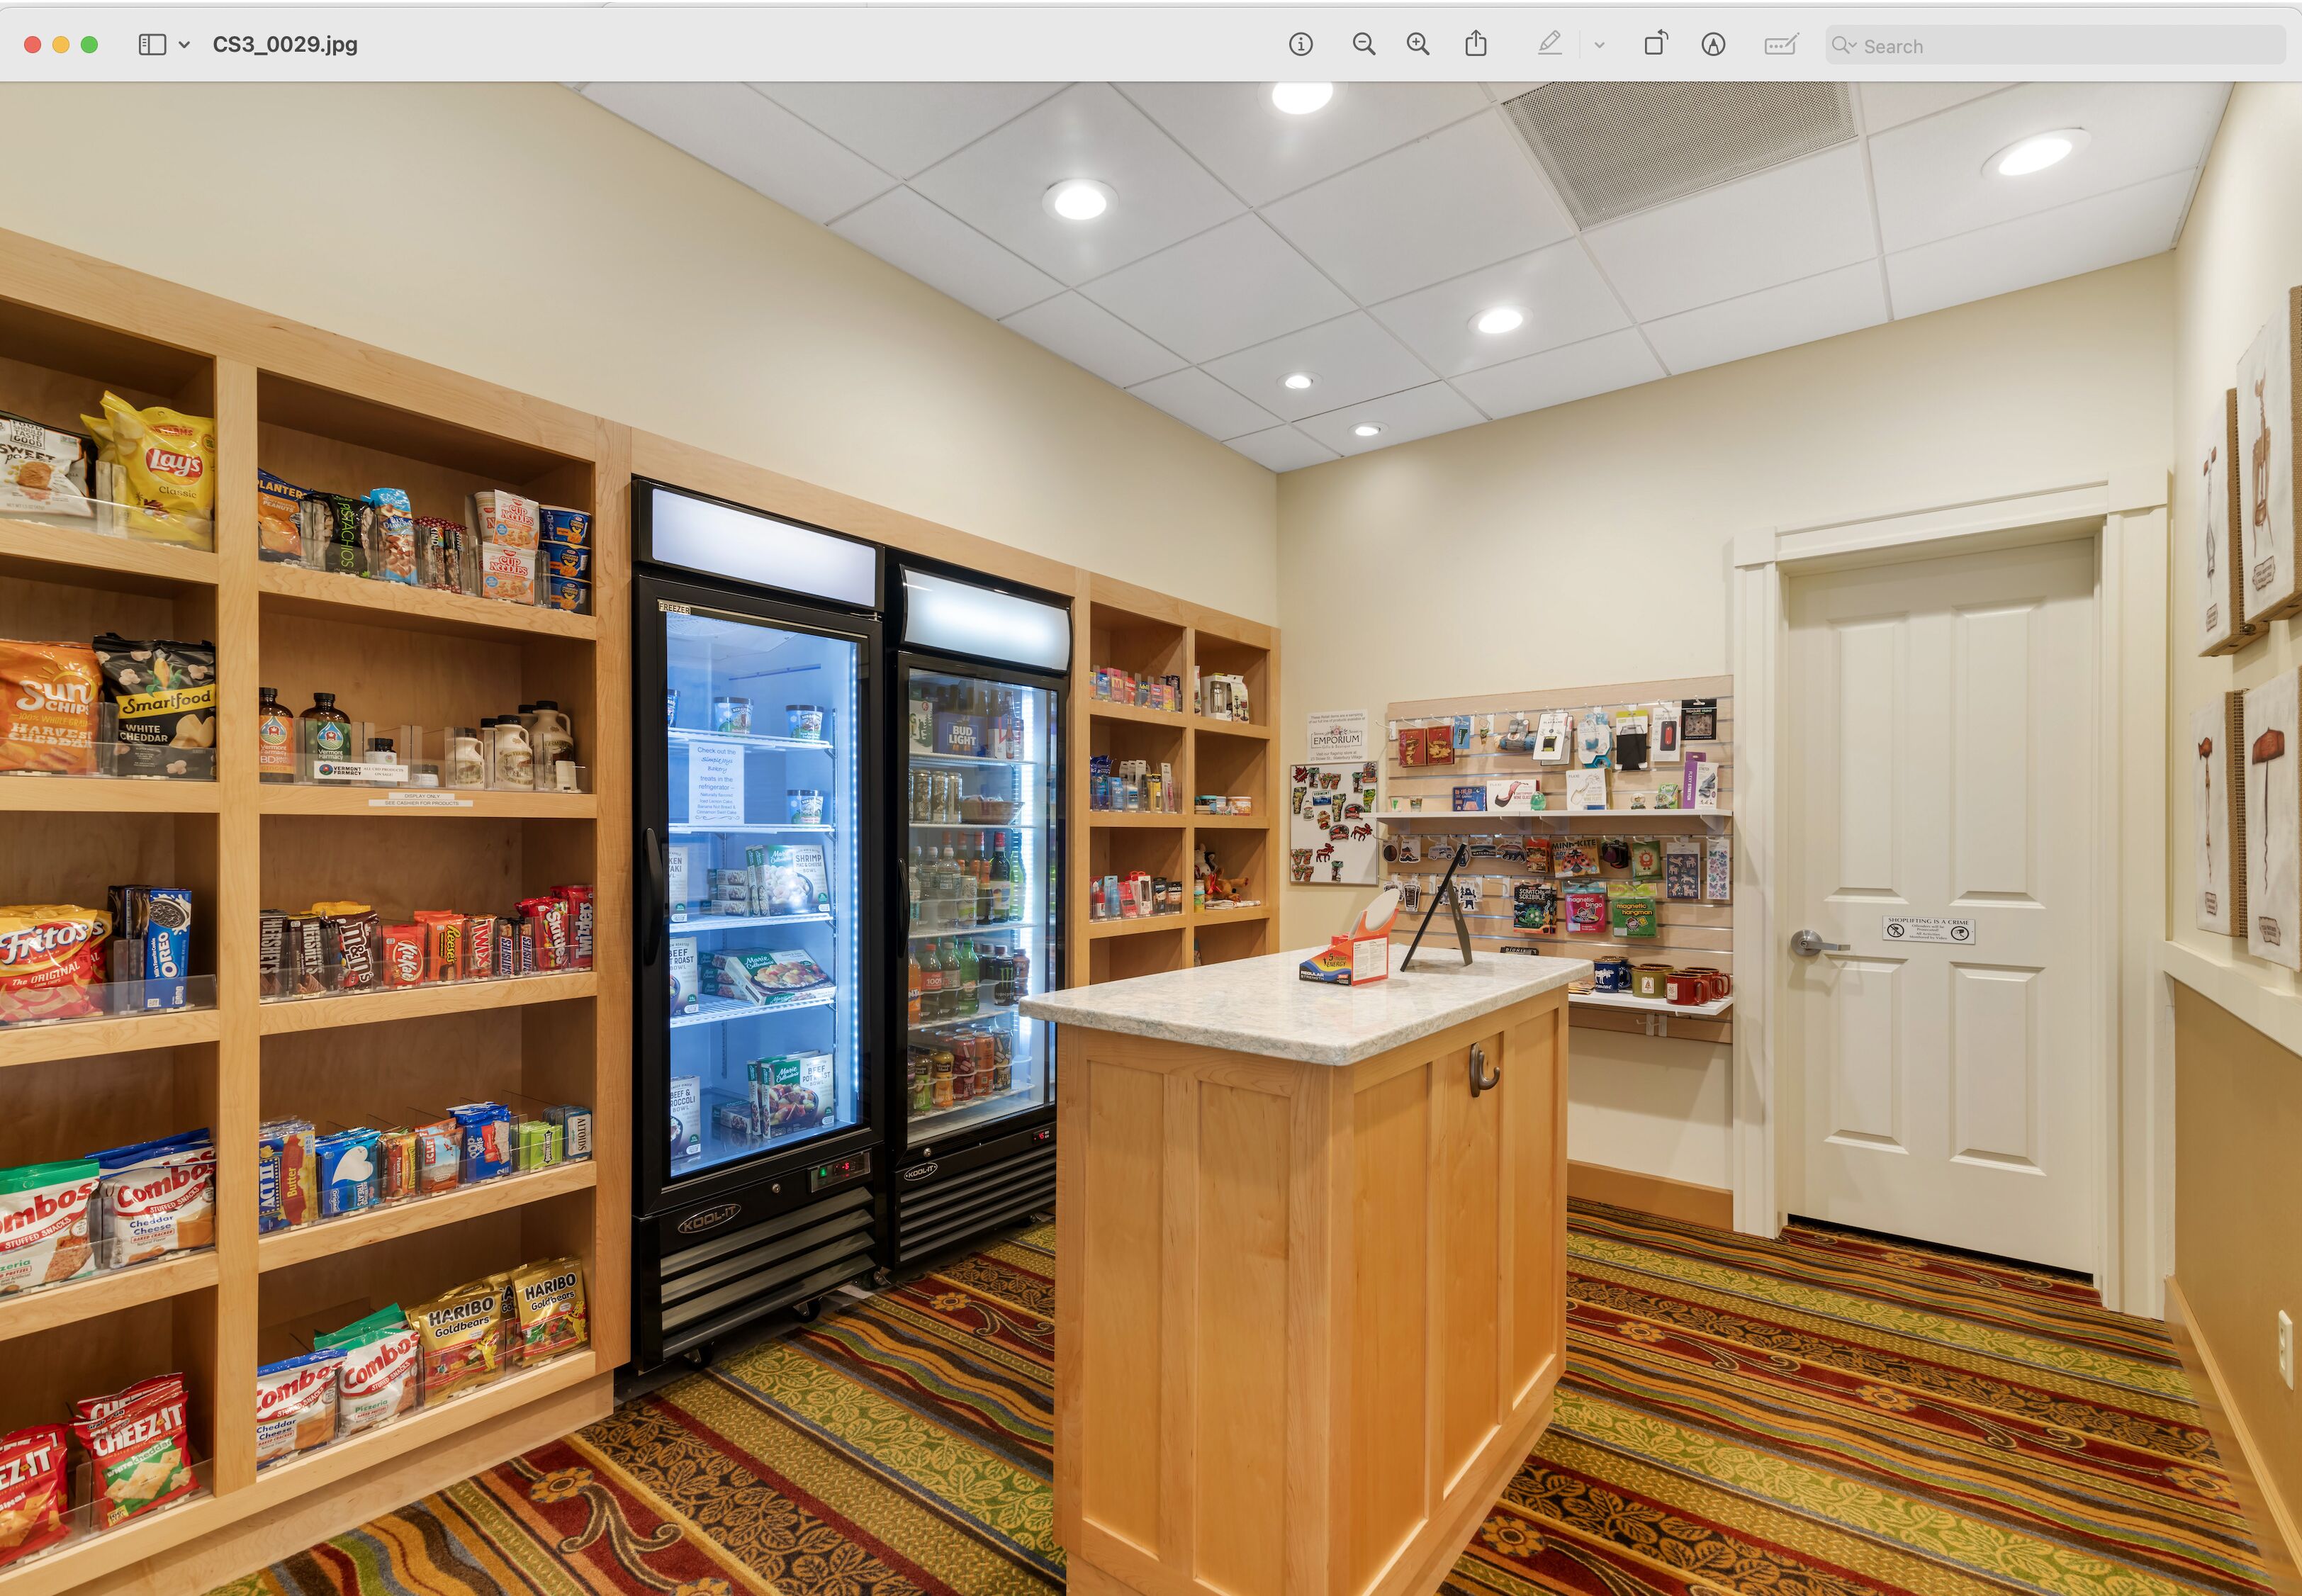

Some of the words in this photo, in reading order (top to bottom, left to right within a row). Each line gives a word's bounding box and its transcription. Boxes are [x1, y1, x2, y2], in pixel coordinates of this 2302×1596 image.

[13, 425, 43, 436] SHOULD
[14, 430, 42, 442] TASTE
[14, 435, 42, 447] GOOD
[0, 444, 56, 461] SWEET
[150, 449, 201, 477] Lay's
[159, 486, 197, 499] Classic
[263, 500, 294, 512] PEANUTS
[509, 504, 527, 516] CUP
[501, 509, 534, 526] NOODLES
[338, 502, 355, 568] PISTACHIOS
[490, 561, 529, 576] NOODLES
[498, 556, 522, 566] CUP
[658, 602, 690, 615] FREEZER
[16, 680, 92, 712] Sun
[123, 690, 212, 714] Smartfood
[11, 722, 93, 740] HARVEST
[120, 731, 168, 743] CHEDDAR
[125, 724, 161, 734] WHITE
[953, 725, 972, 736] BUD
[948, 734, 977, 746] LIGHT
[1314, 735, 1359, 745] EMPORIUM
[795, 854, 822, 862] SHRIMP
[0, 924, 89, 965] Fritos
[260, 919, 283, 975] HERSHEY'S
[446, 924, 461, 964] Reese's
[472, 919, 493, 968] TWIX
[545, 911, 566, 965] Skittles
[159, 932, 178, 978] OREO
[303, 923, 325, 975] HERSHEY'S
[500, 937, 513, 976] SATISFIES
[746, 956, 770, 965] Marie
[30, 964, 81, 984] ORIGINAL
[776, 1066, 798, 1077] Marie
[808, 1064, 826, 1075] BEEF
[577, 1118, 587, 1152] ALTOIDS
[426, 1138, 435, 1157] CLIF
[908, 1164, 935, 1179] KOOL-IT
[117, 1164, 215, 1209] Combos
[286, 1167, 298, 1198] Butter
[150, 1201, 177, 1213] STUFFED
[177, 1186, 200, 1206] SNACKS
[260, 1182, 275, 1208] ACT
[329, 1188, 340, 1213] Original
[130, 1215, 174, 1228] Cheddar
[683, 1205, 736, 1232] KOOL-IT
[5, 1234, 40, 1249] STUFFED
[41, 1217, 72, 1236] SNACKS
[133, 1223, 172, 1235] Cheese
[150, 1230, 174, 1240] CRACKER
[6, 1267, 29, 1276] PRETZEL
[524, 1272, 578, 1302] HARIBO
[531, 1290, 576, 1312] Goldbears
[428, 1296, 495, 1328] HARIBO
[434, 1316, 490, 1339] Goldbears
[344, 1331, 420, 1390] Combos
[390, 1361, 410, 1381] SNACKS
[303, 1387, 324, 1407] SNACKS
[355, 1399, 388, 1414] Pizzeria
[87, 1420, 106, 1429] Grab
[257, 1418, 297, 1434] Cheddar
[259, 1427, 292, 1441] Cheese
[133, 1437, 172, 1464] cheddar
